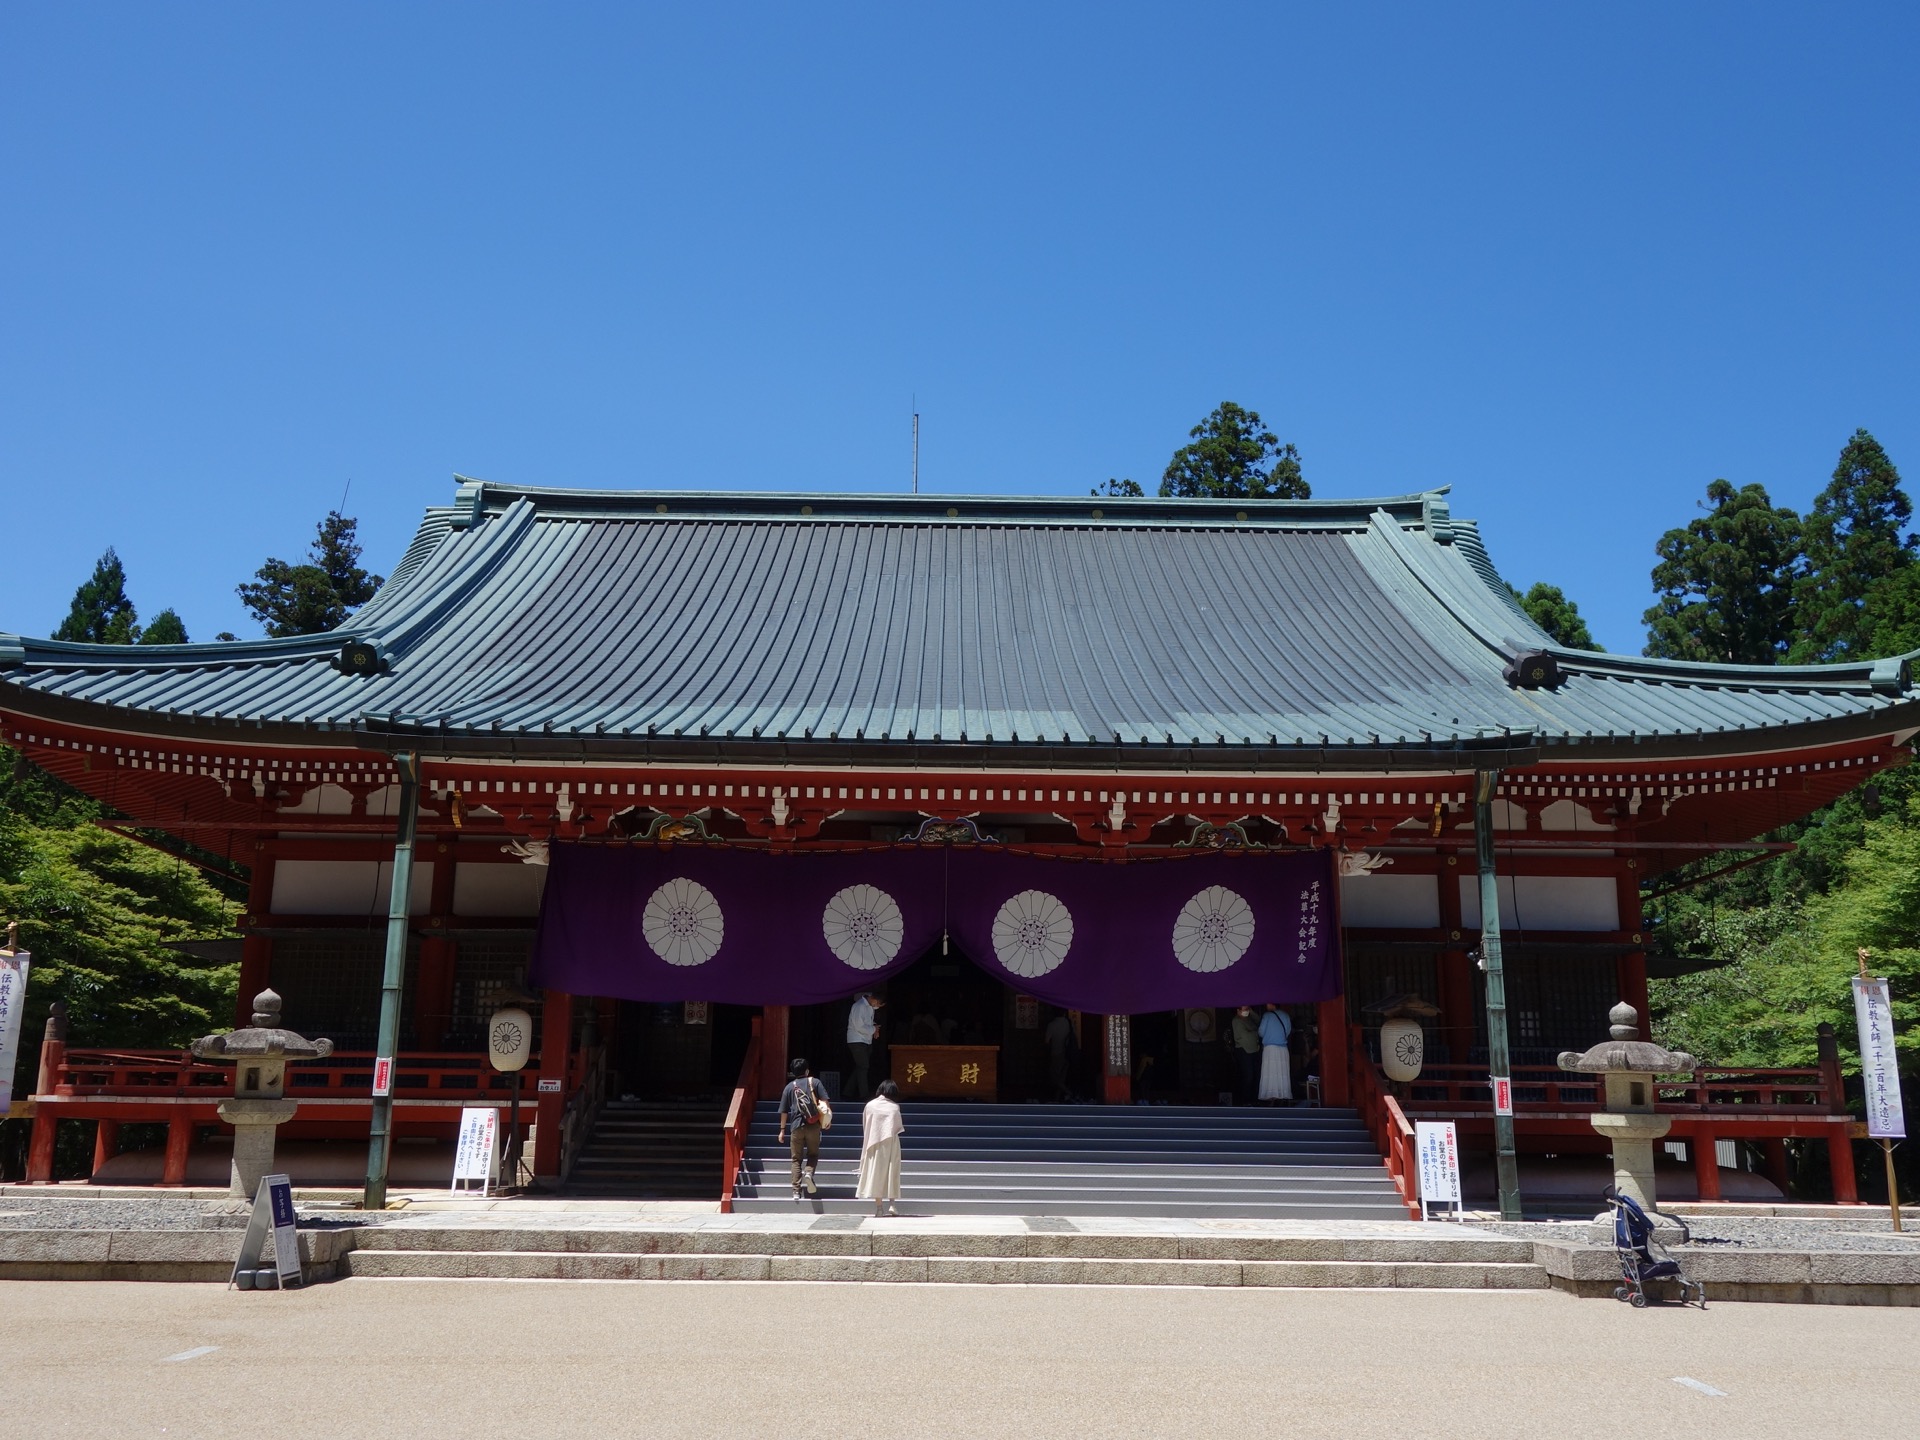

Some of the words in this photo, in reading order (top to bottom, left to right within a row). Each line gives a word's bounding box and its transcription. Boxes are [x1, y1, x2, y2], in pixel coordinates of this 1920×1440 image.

[1297, 890, 1310, 964] 法華大会記念
[1307, 880, 1320, 948] 平成十九年度
[906, 1062, 980, 1084] 浄財
[1867, 998, 1891, 1131] 伝教大師一千二百年大遠忌
[1429, 1132, 1438, 1170] ご自由に中へ
